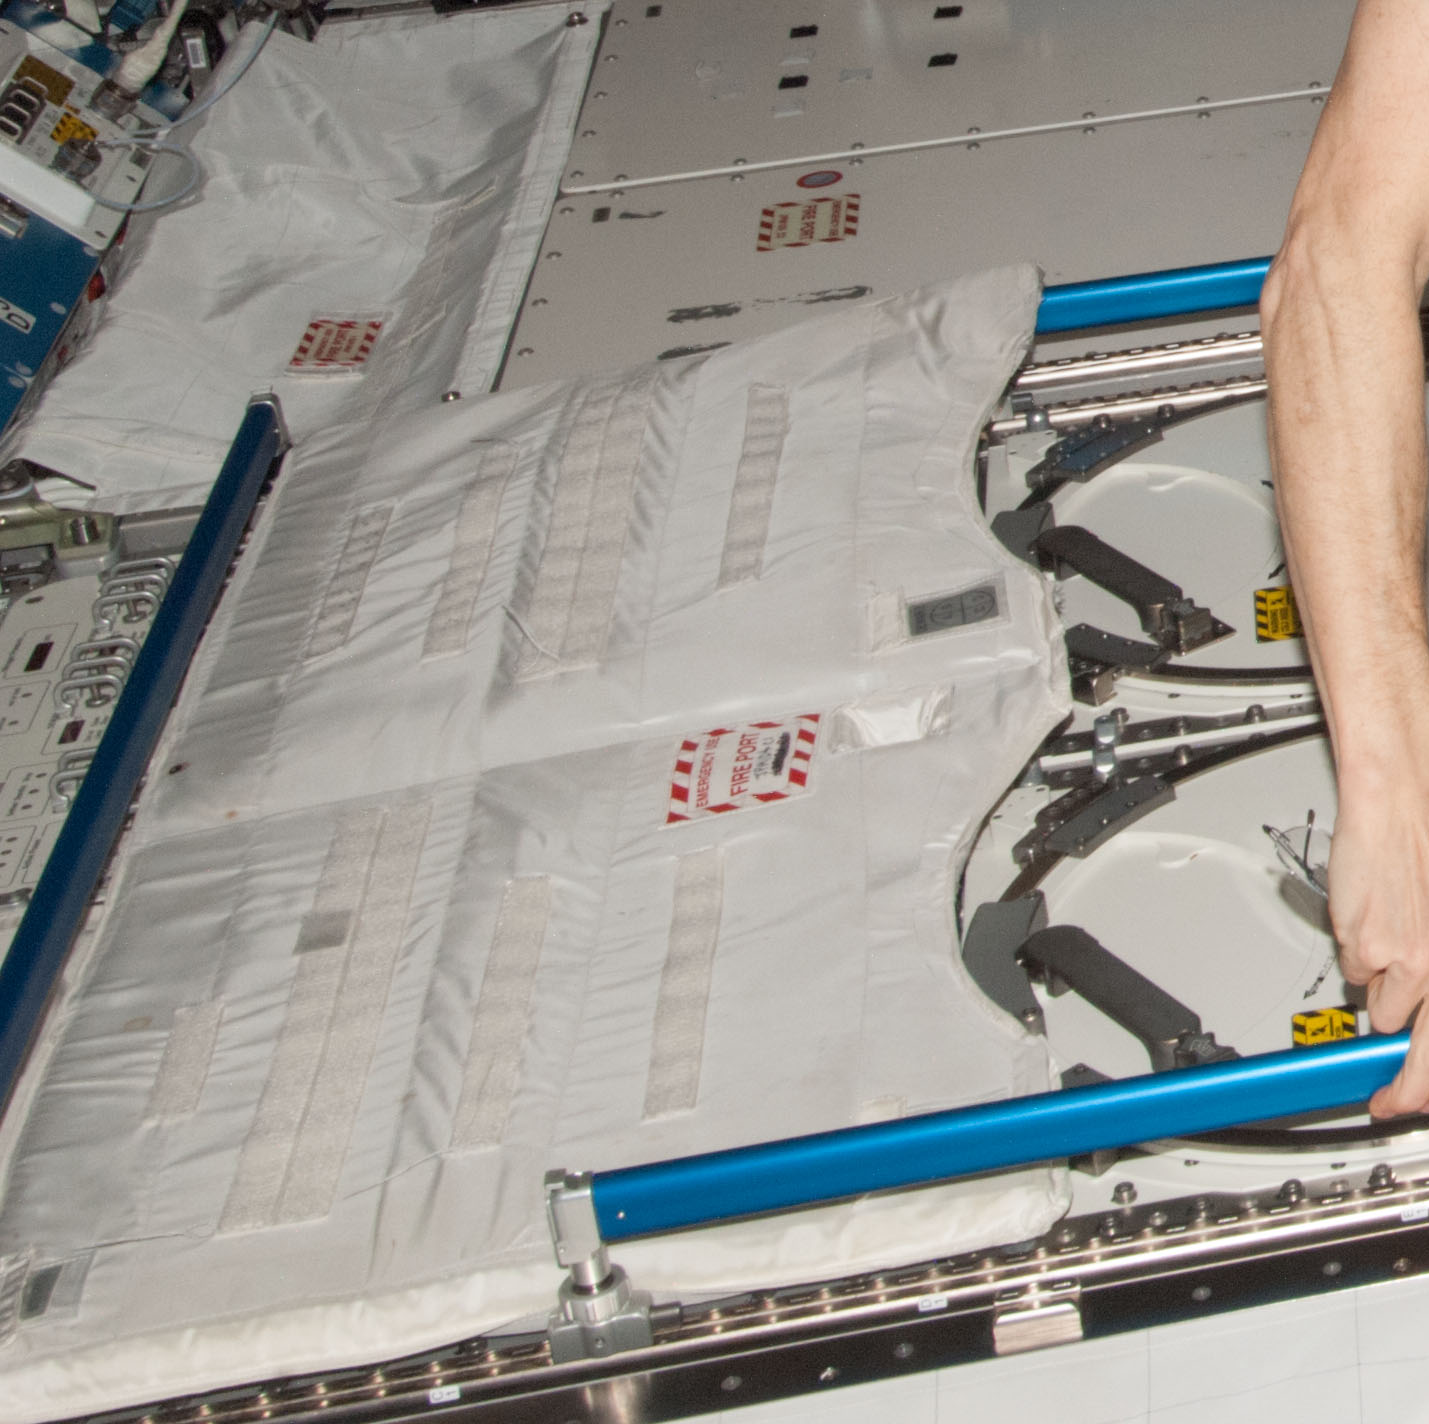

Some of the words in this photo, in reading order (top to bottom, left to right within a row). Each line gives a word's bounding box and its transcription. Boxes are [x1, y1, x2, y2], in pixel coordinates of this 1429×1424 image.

[801, 204, 816, 220] FIRE
[799, 221, 814, 240] PORT
[704, 736, 720, 750] USE
[736, 732, 760, 762] PORT
[696, 752, 715, 808] EMERGENCY
[730, 763, 752, 797] FIRE
